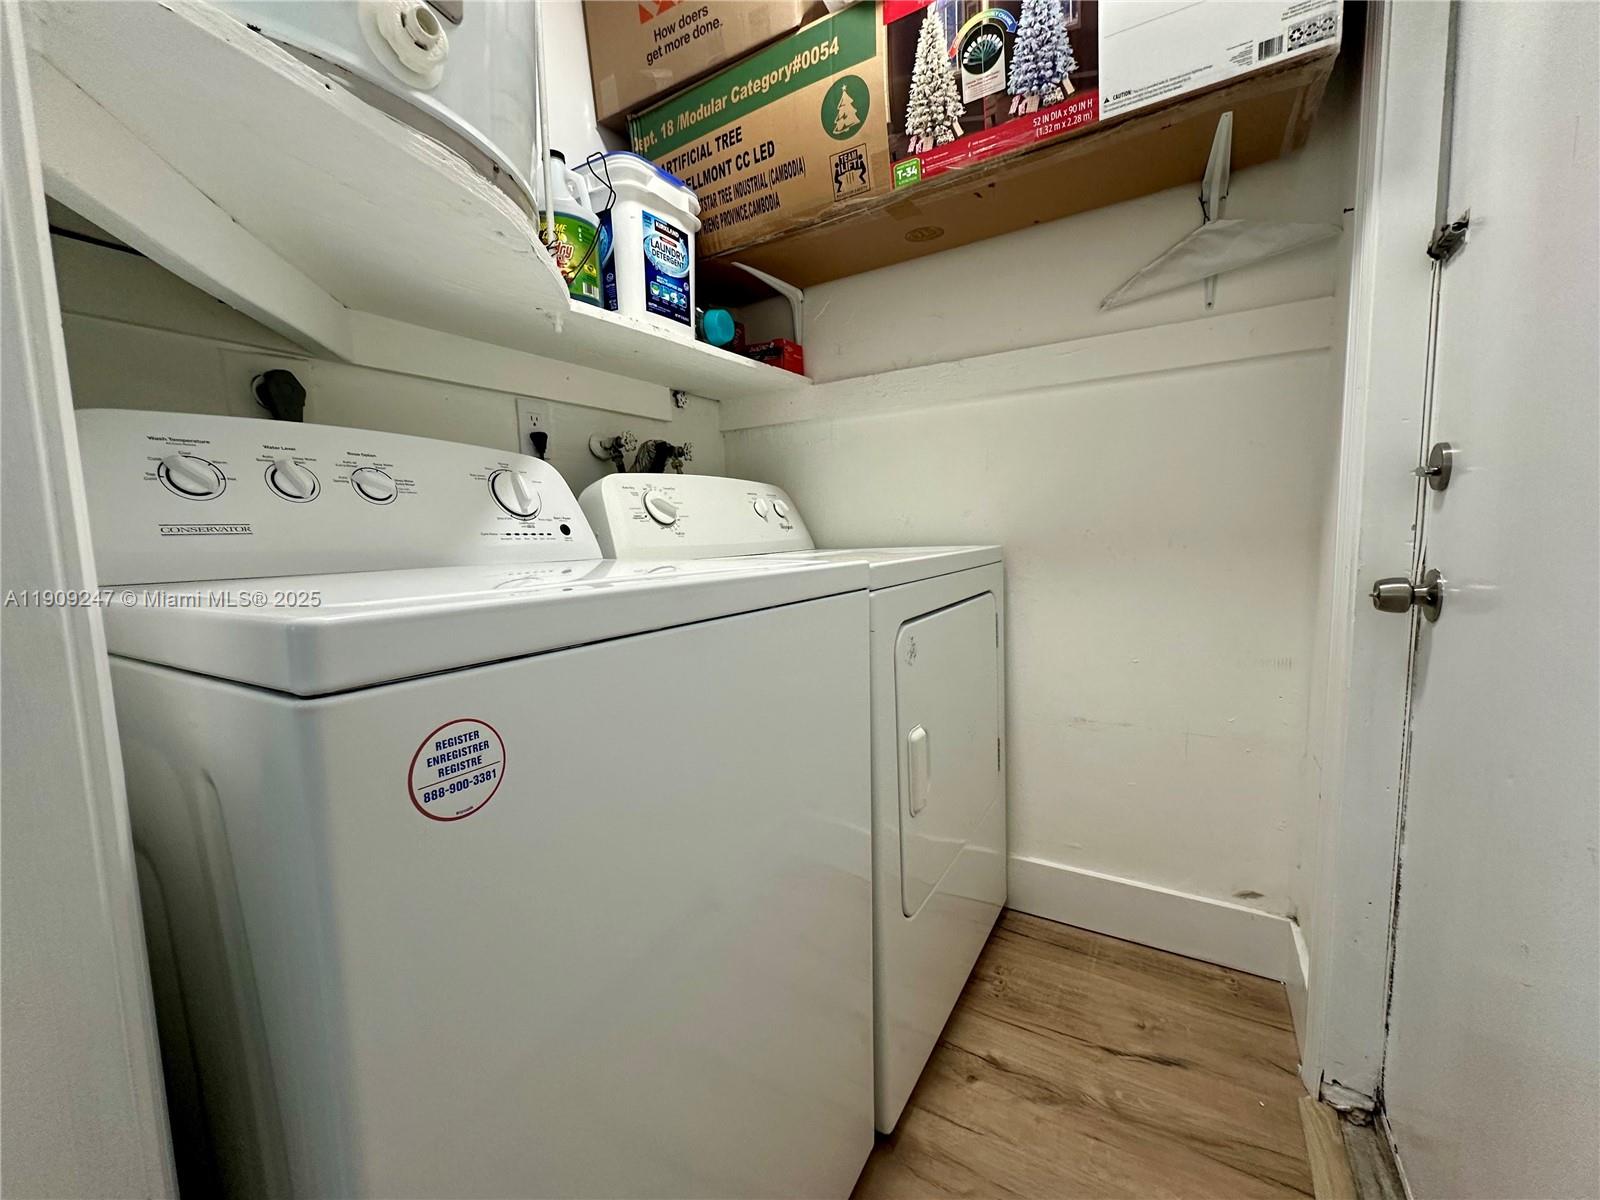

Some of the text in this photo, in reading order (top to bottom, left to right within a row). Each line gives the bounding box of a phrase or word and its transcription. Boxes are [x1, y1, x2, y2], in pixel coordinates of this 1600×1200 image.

[654, 5, 709, 42] How doers
[646, 18, 723, 66] get more done.
[661, 119, 674, 139] 18
[677, 95, 728, 132] /Modular
[731, 36, 839, 103] Category#0054
[1033, 98, 1093, 127] 52 IN DIA x 90 IN H
[1036, 124, 1053, 138] (1.32
[1067, 114, 1082, 127] 2.28
[661, 126, 742, 174] ARTIFICIAL TREE
[839, 151, 858, 164] TEAM
[682, 140, 775, 191] ELLMONT CC LED
[897, 166, 917, 180] T-34
[718, 186, 733, 206] TREE
[733, 172, 768, 201] INDUSTRIAL
[768, 155, 806, 190] (CAMBODIA)
[651, 238, 686, 261] LAUNDRY
[651, 248, 684, 269] DETERGENT
[160, 526, 252, 534] CONSERVATOR
[426, 740, 490, 768] ENREGISTRER
[435, 730, 480, 751] REGISTER
[438, 755, 482, 778] REGISTRE
[423, 768, 497, 803] 888-900-3381
